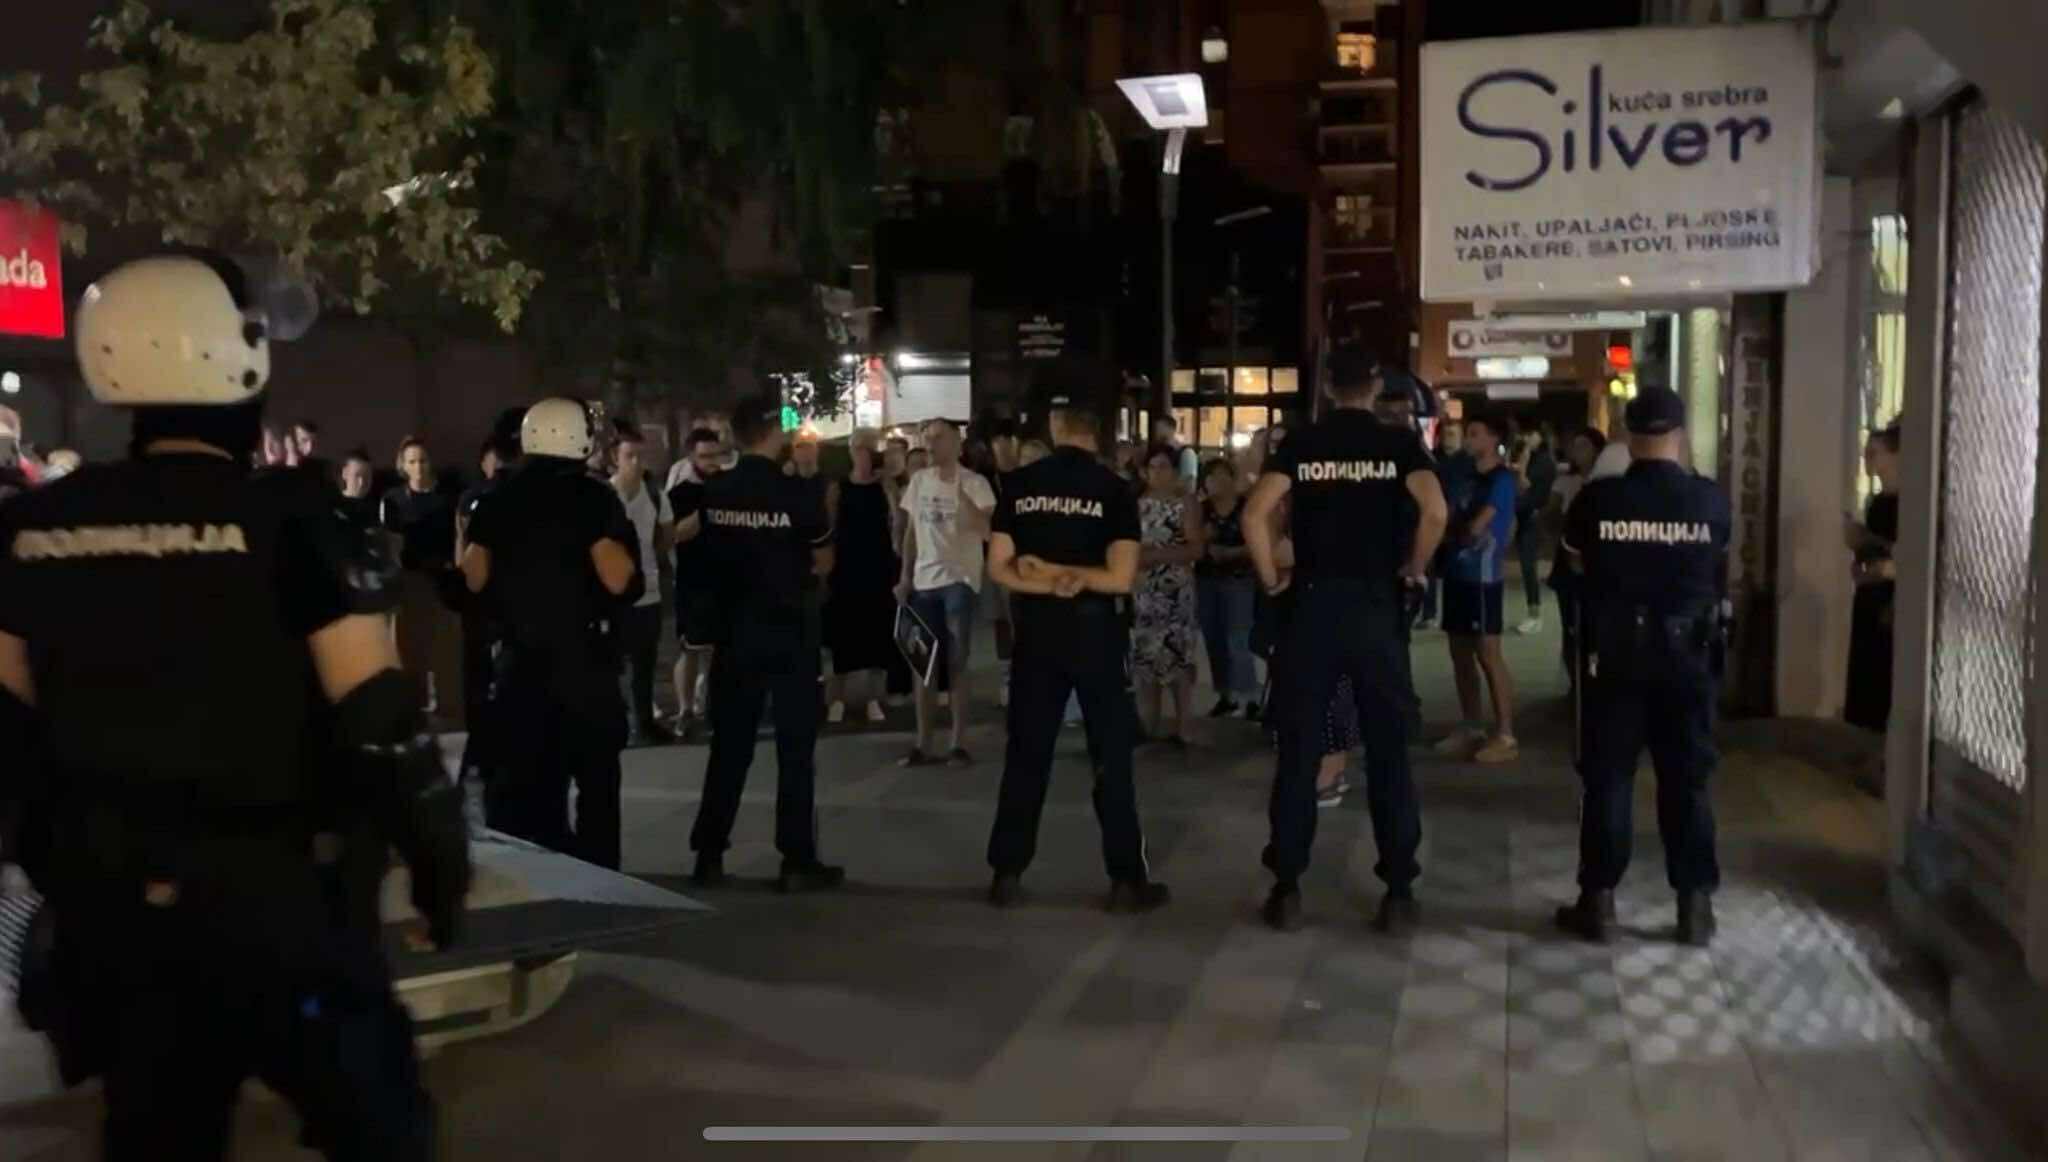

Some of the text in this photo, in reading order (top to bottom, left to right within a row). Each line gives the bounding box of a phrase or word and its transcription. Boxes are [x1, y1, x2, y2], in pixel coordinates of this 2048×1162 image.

[1681, 84, 1769, 107] srebra
[1457, 63, 1772, 191] Silver
[1297, 460, 1398, 483] ПОЛИЦИЈА
[706, 507, 792, 530] ПОЛИЦИЈА
[1015, 495, 1104, 519] ПОЛИЦИЈА
[1599, 519, 1712, 546] ПОЛИЦИЈА
